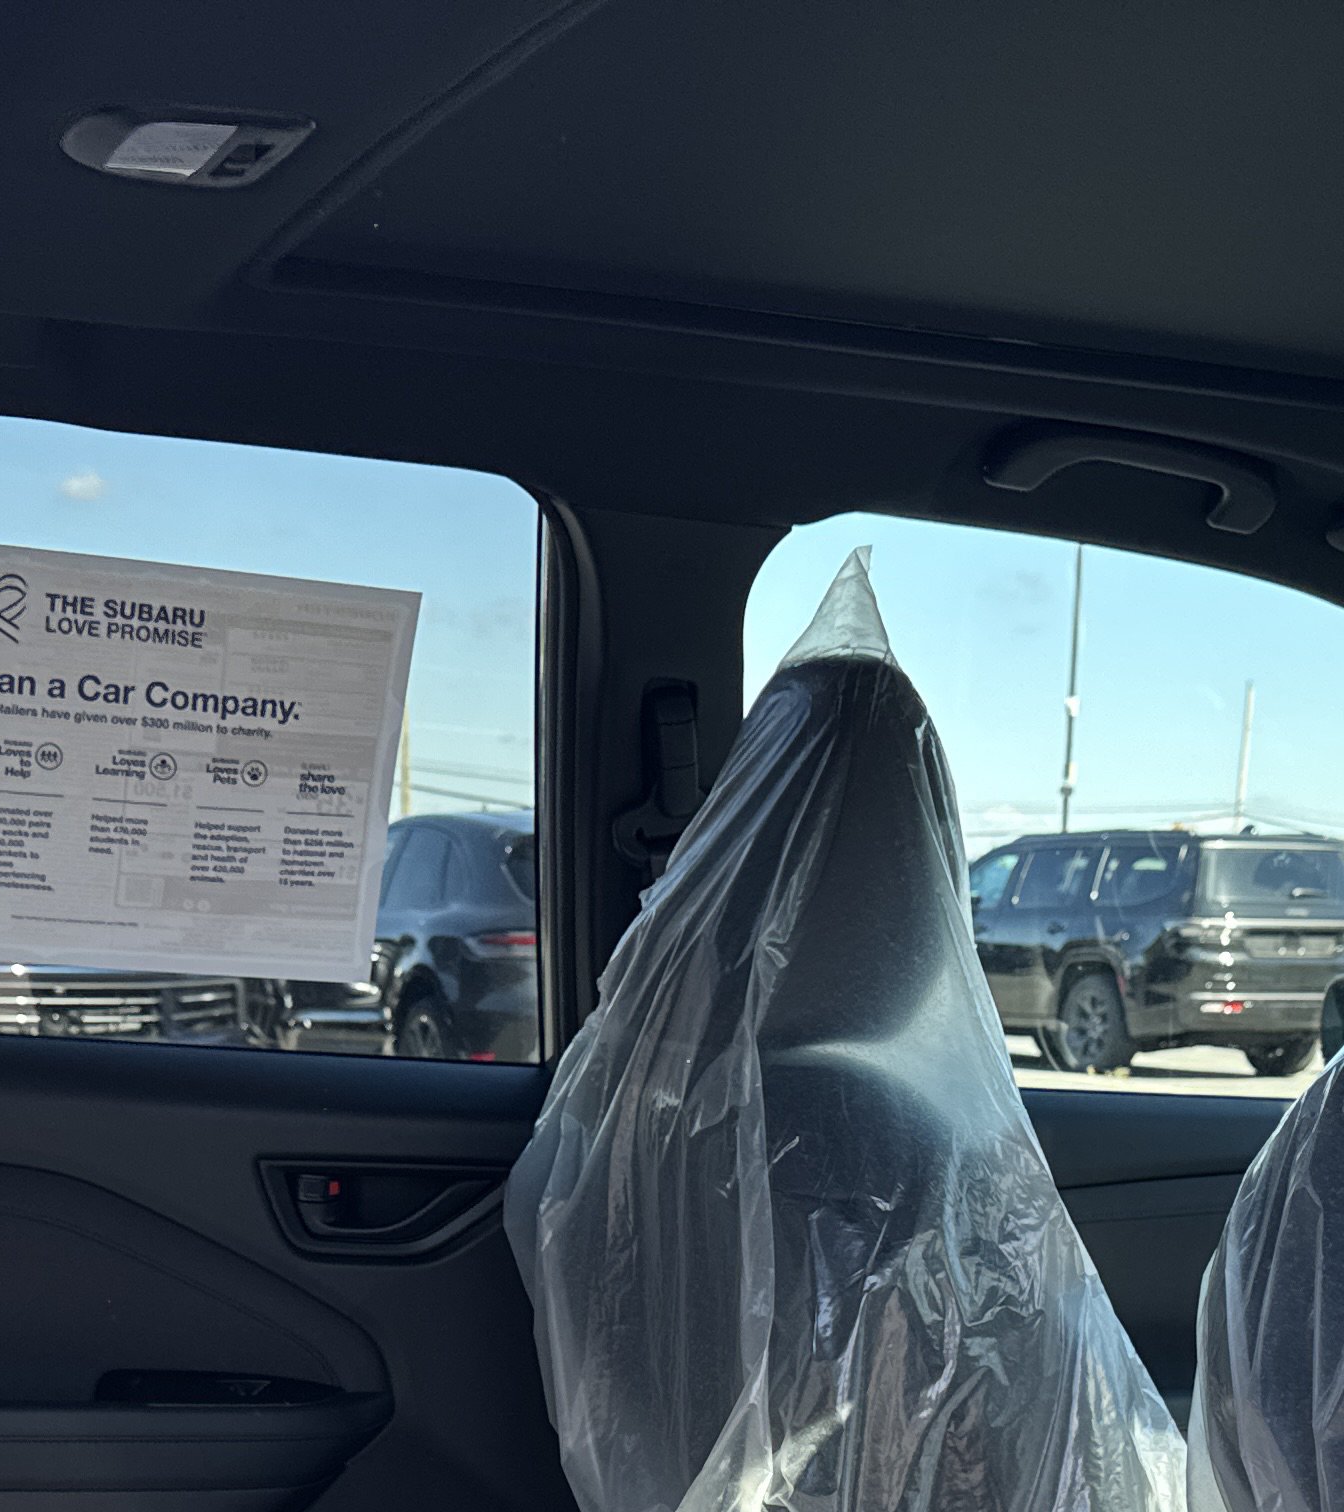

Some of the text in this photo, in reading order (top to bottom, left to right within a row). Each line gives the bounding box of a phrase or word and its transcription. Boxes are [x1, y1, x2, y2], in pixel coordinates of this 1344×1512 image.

[45, 593, 205, 628] THE SUBARU
[45, 616, 203, 649] LOVE PROMISE
[47, 672, 65, 699] a
[78, 675, 135, 705] Car
[145, 682, 301, 725] Company.
[42, 708, 70, 720] have
[75, 709, 107, 725] given
[111, 714, 137, 726] over
[142, 714, 169, 729] $300
[173, 718, 212, 732] million
[217, 723, 228, 734] to
[232, 724, 273, 740] charity.
[20, 758, 31, 767] to
[113, 756, 146, 767] Loves
[5, 767, 31, 779] Help
[96, 765, 145, 780] Learning
[207, 764, 238, 775] Loves
[213, 774, 237, 785] Pets
[300, 771, 334, 783] share
[299, 783, 346, 795] the love
[33, 810, 53, 818] over
[91, 814, 123, 825] Helped
[29, 820, 51, 829] pairs
[91, 825, 110, 833] than
[194, 822, 261, 832] Helped support
[2, 829, 29, 838] socks
[31, 831, 49, 839] and
[194, 832, 207, 840] the
[284, 826, 343, 837] Donated more
[90, 836, 128, 845] students
[226, 845, 266, 854] transport
[211, 855, 236, 863] health
